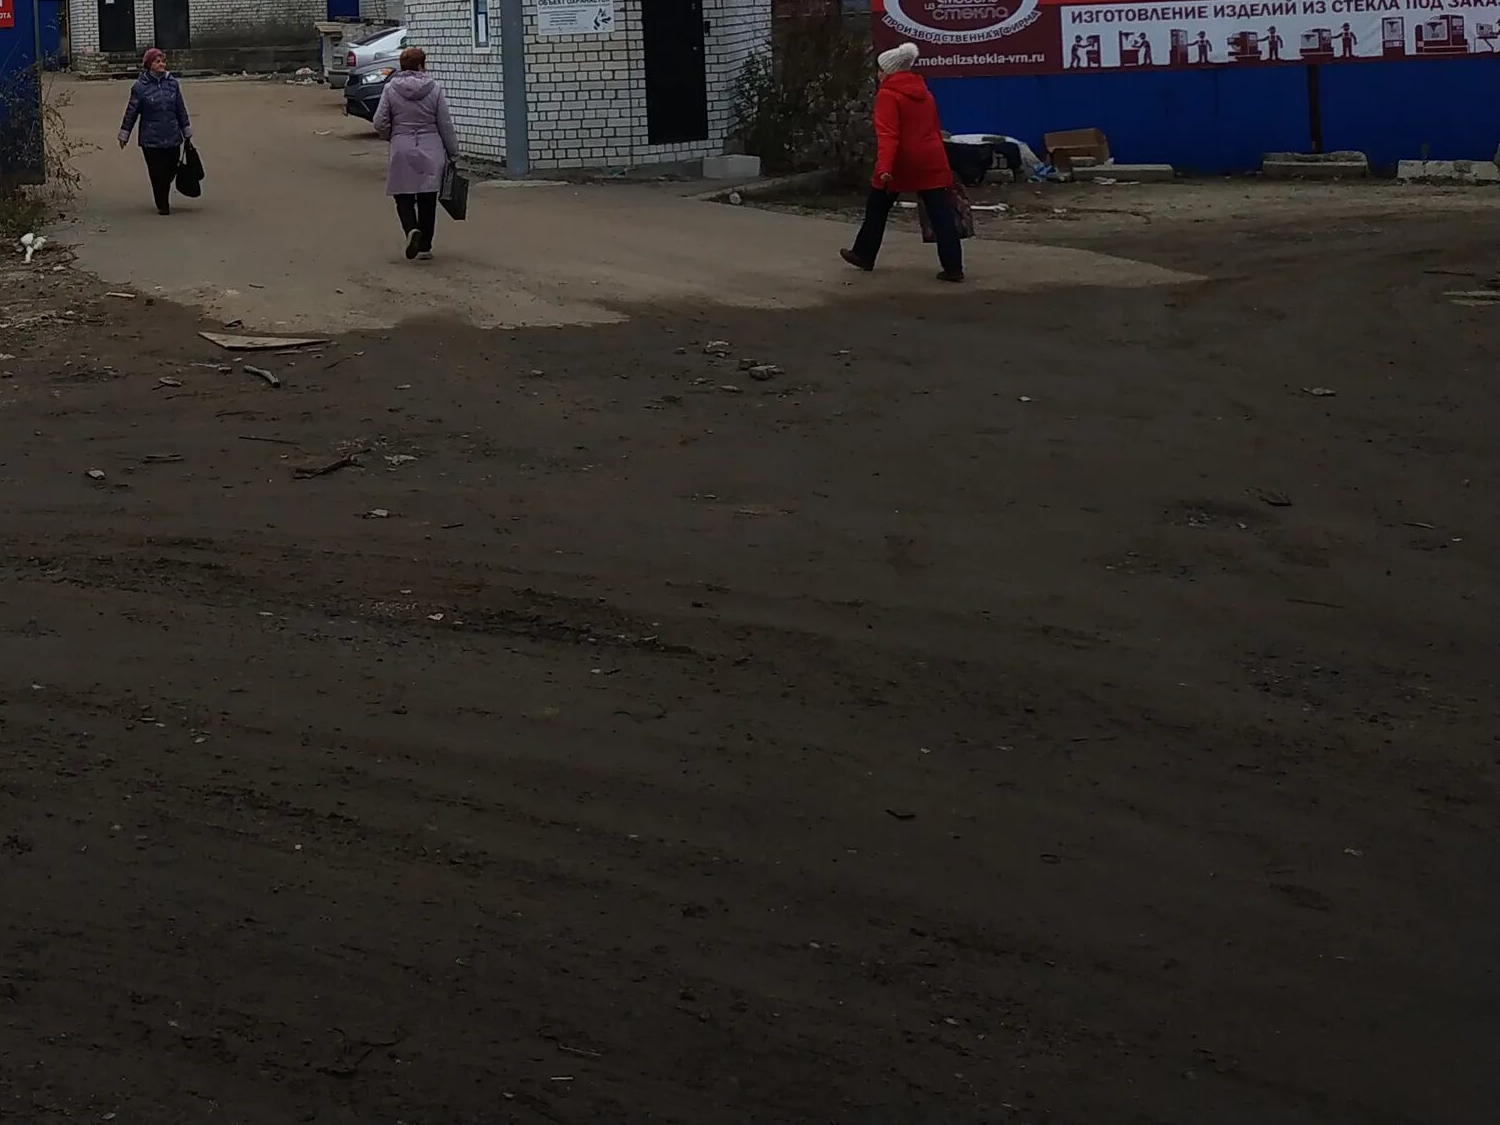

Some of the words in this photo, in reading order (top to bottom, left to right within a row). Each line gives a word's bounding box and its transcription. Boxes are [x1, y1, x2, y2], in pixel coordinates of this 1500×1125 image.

[924, 2, 936, 11] из
[932, 6, 1009, 21] стекла
[1071, 5, 1208, 24] ИЗГОТОВЛЕНИЕ
[1303, 1, 1326, 14] ИЗ
[884, 15, 1001, 44] ПРОИЗВОДСТВЕННАЯ
[1002, 10, 1041, 36] ФИРМА
[911, 53, 1045, 67] .mebelizstekla-vrn.ru
